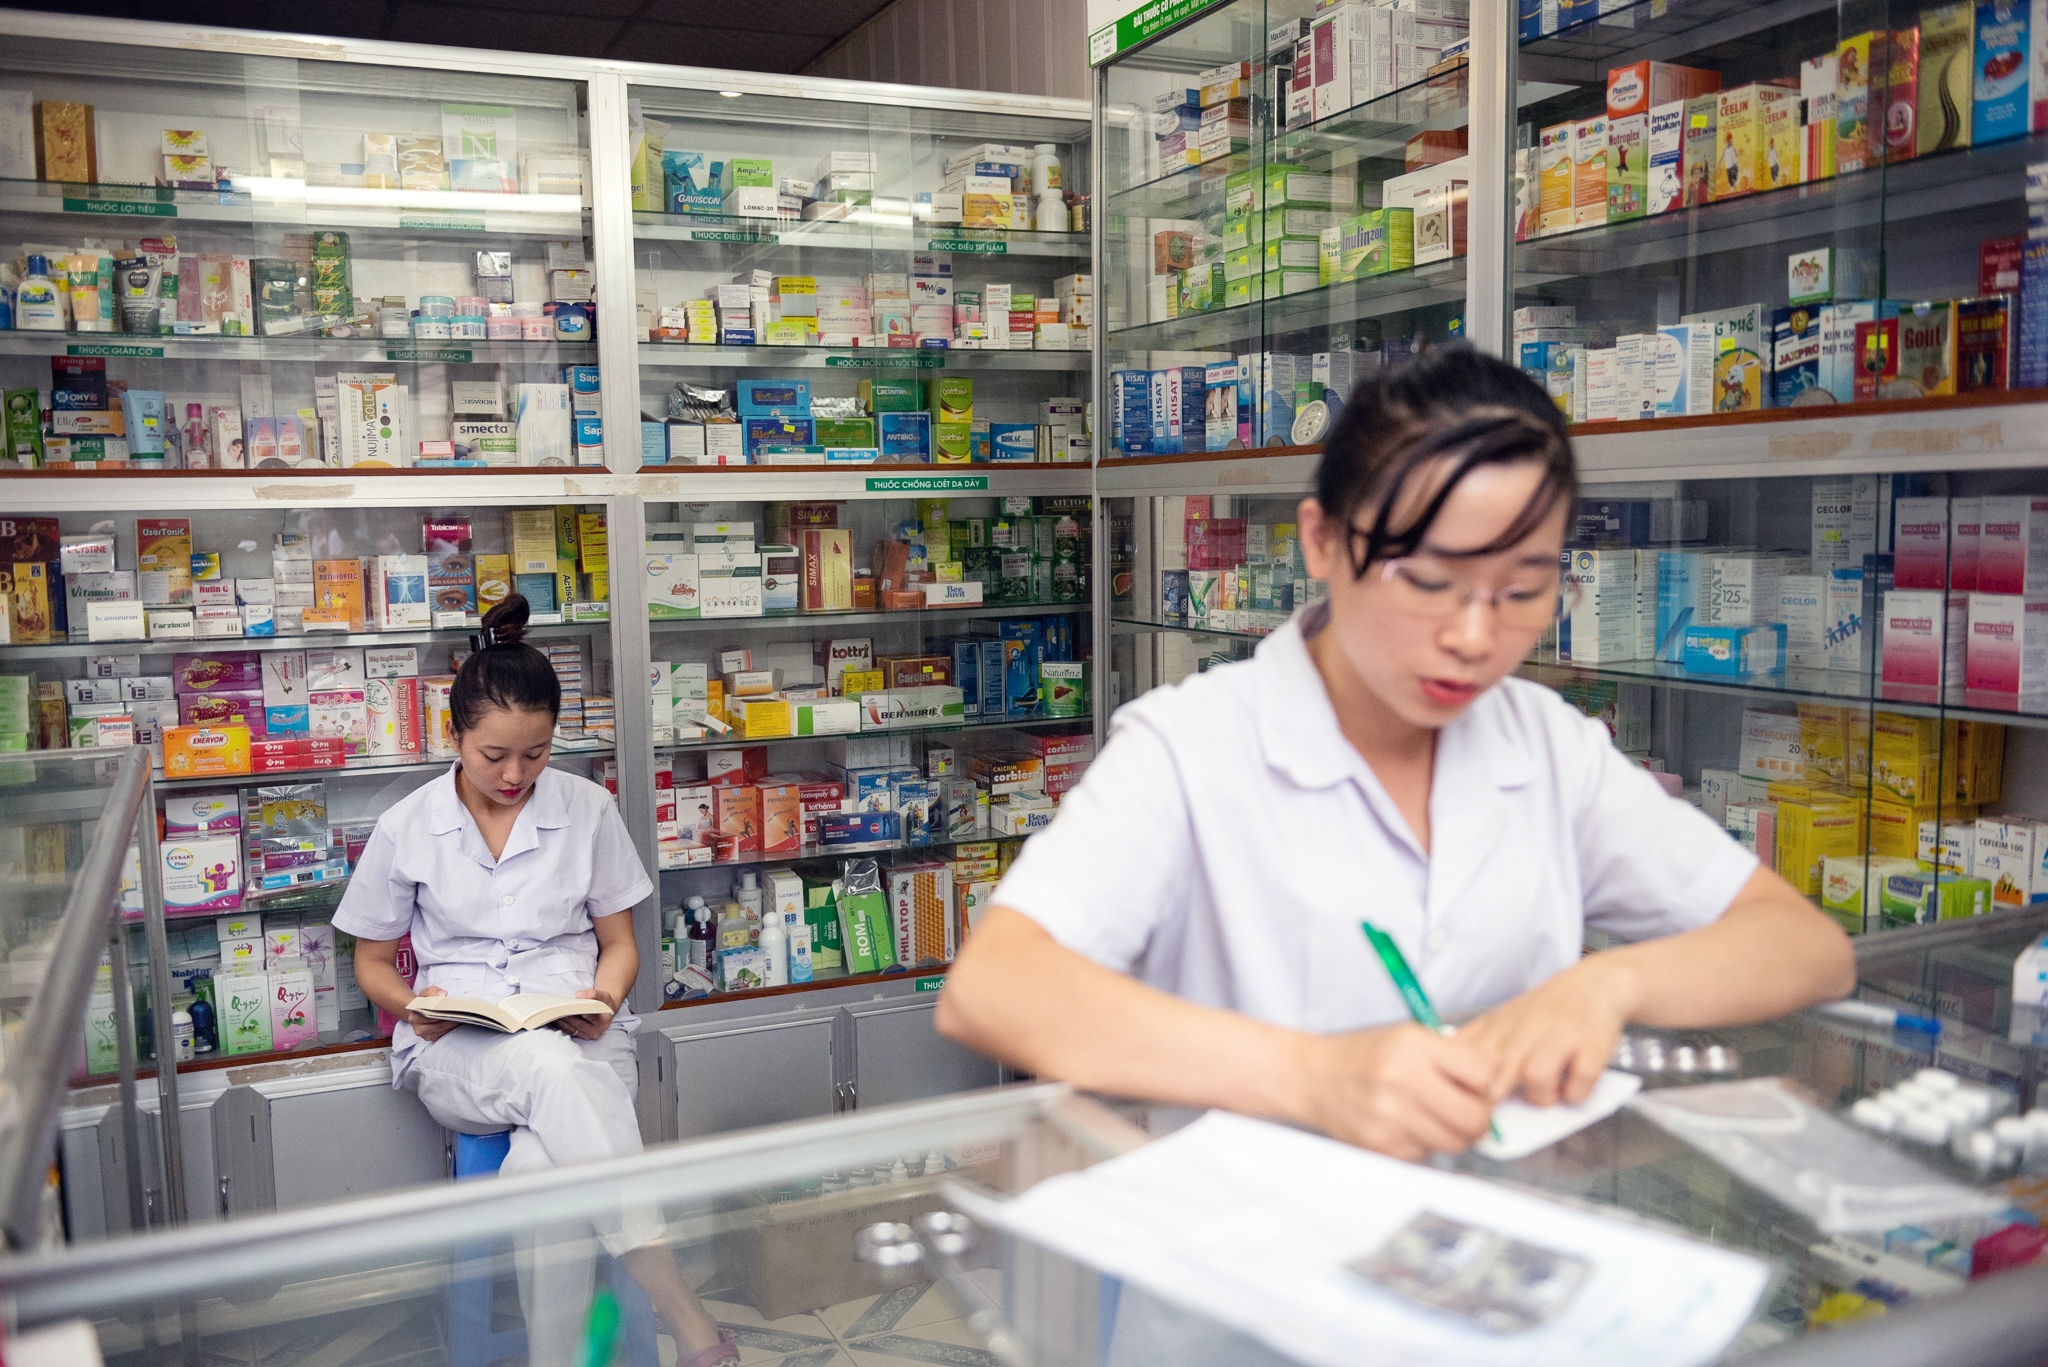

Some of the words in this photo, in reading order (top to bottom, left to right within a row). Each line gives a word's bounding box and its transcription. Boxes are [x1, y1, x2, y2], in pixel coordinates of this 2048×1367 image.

[1143, 2, 1160, 23] THUỐC
[1150, 20, 1160, 34] thêm
[1612, 83, 1638, 96] Pharmaton
[1720, 101, 1749, 117] CEELIN
[462, 116, 497, 125] NOIGEL
[1651, 112, 1679, 122] Imuno
[1764, 109, 1788, 125] CEELIN
[1651, 119, 1681, 135] glukan
[1608, 128, 1640, 148] Nutroplex
[737, 166, 769, 176] Ampelop
[678, 194, 720, 206] GAVISCON
[86, 202, 118, 212] THUỐC
[744, 204, 774, 212] LOMAC-20
[1342, 225, 1384, 252] Inulinzor
[932, 242, 956, 250] THUỐC
[958, 242, 974, 251] ĐIỀU
[1904, 327, 1941, 352] Gout
[78, 346, 110, 355] THUỐC
[60, 358, 84, 366] trứng
[1657, 353, 1676, 362] Avamys
[1124, 373, 1145, 382] XISAT
[1183, 370, 1204, 379] XISAT
[876, 387, 906, 396] Lactomin
[942, 386, 967, 397] goldbee
[1170, 379, 1178, 418] XISAT
[459, 424, 509, 435] smecta
[368, 420, 376, 457] NUJIMA
[940, 433, 965, 443] goldbee
[1001, 435, 1021, 444] BIOLAC
[74, 440, 101, 448] Acnes
[874, 480, 900, 489] THUỐC
[901, 479, 931, 489] CHỐNG
[933, 479, 949, 488] LOÉT
[951, 481, 963, 490] DẠ
[964, 479, 980, 488] DÀY
[797, 510, 830, 520] SIMAX
[67, 544, 107, 554] L-CYSTINE
[809, 553, 817, 586] SIMAX
[70, 588, 114, 598] Vitamin
[117, 590, 129, 599] 3B
[199, 585, 219, 593] Rutin
[221, 585, 229, 593] C
[945, 590, 965, 598] Juvit
[1781, 596, 1817, 606] CECLOR
[153, 621, 191, 630] Farzincol
[897, 672, 931, 684] Cardus
[1043, 668, 1081, 678] Naturenz
[192, 735, 224, 745] ENERVON
[1047, 743, 1086, 754] corbière
[993, 771, 1040, 782] corbière
[1029, 813, 1047, 822] Bee
[263, 843, 300, 853] EUnanokid
[1979, 837, 2008, 850] CEFIXIM
[2010, 841, 2024, 852] 100
[778, 891, 800, 899] Lactacyd
[785, 913, 797, 923] BB
[901, 899, 909, 961] PHILATOP
[855, 923, 871, 957] ROM
[172, 966, 212, 978] Nabifar
